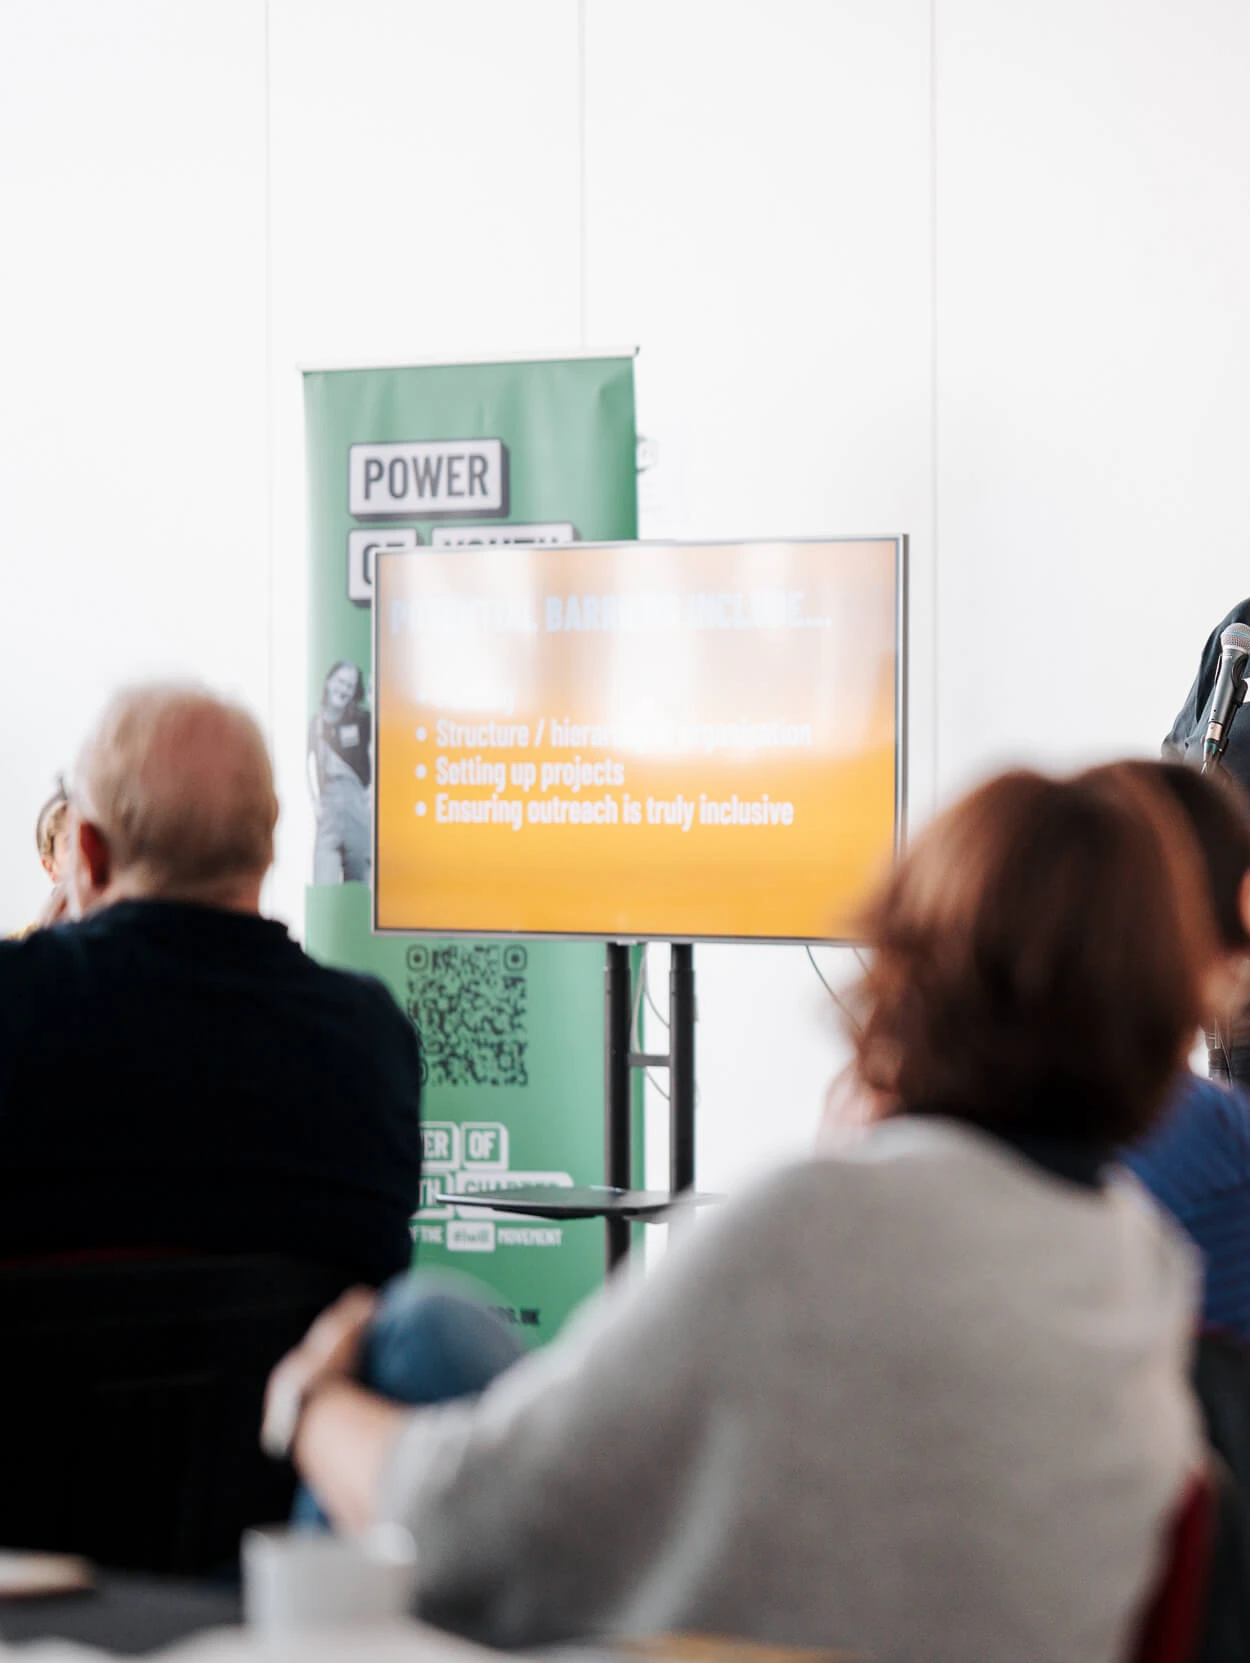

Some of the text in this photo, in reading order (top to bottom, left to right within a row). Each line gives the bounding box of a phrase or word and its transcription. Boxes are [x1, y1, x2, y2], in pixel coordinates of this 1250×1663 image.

[363, 454, 489, 500] POWER
[436, 719, 529, 748] Structure
[436, 756, 625, 793] Setting up projects
[435, 793, 794, 832] Ensuring outreach is truly inclusive
[468, 1130, 496, 1160] OF
